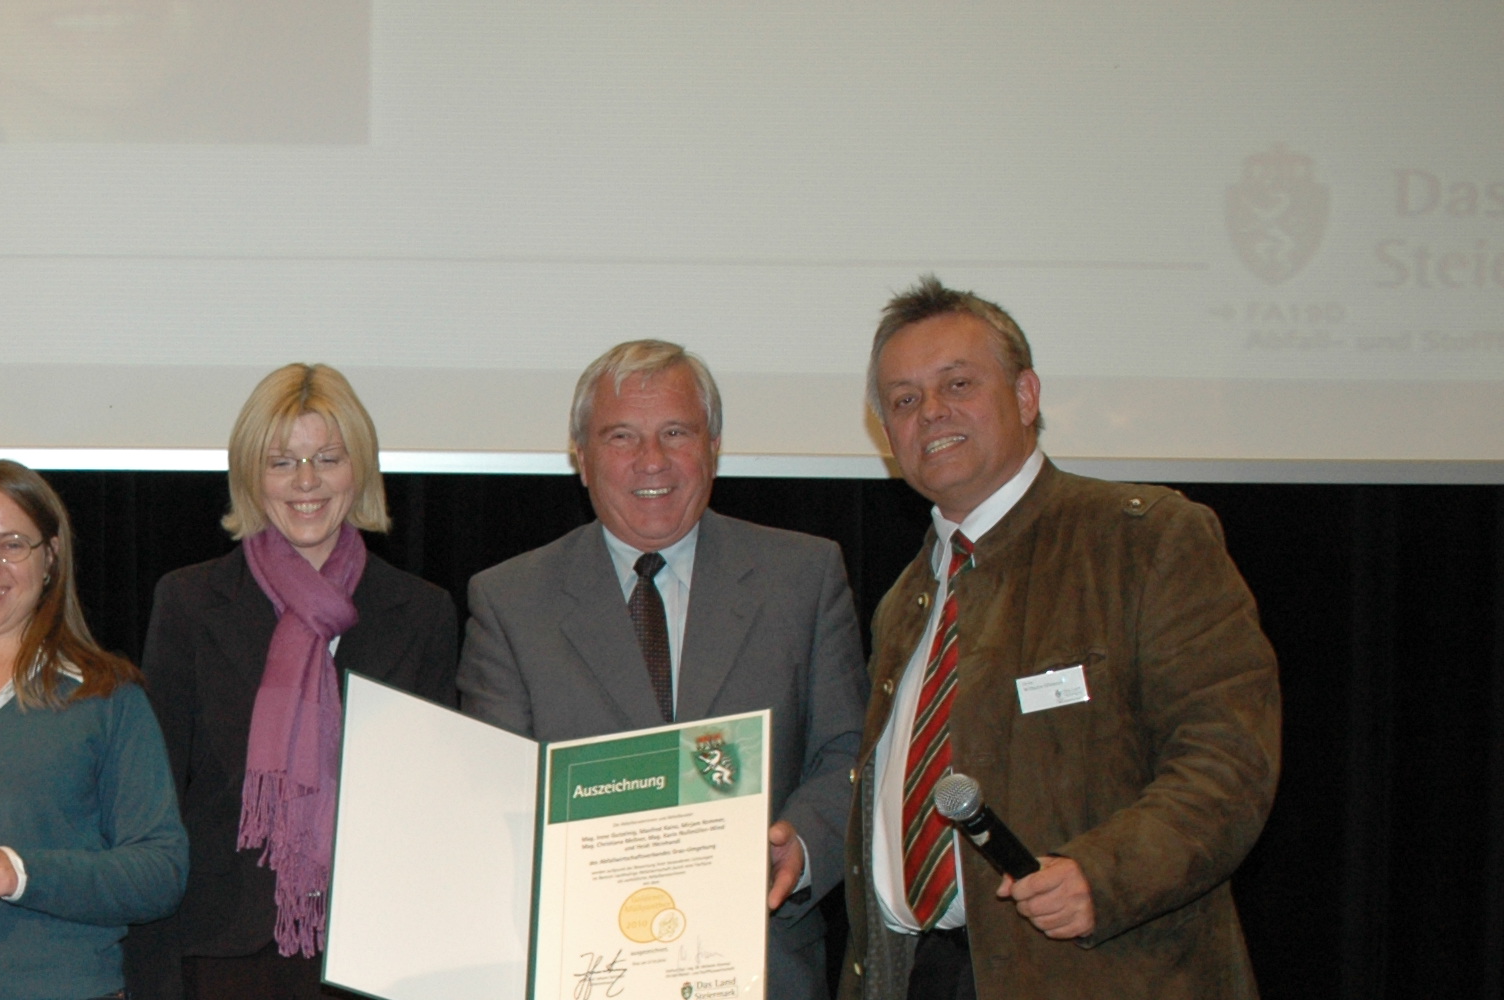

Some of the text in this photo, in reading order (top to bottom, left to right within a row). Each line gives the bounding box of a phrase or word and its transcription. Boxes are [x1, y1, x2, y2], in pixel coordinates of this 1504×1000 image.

[573, 776, 665, 798] Auszeichnung
[696, 977, 736, 990] Das Land
